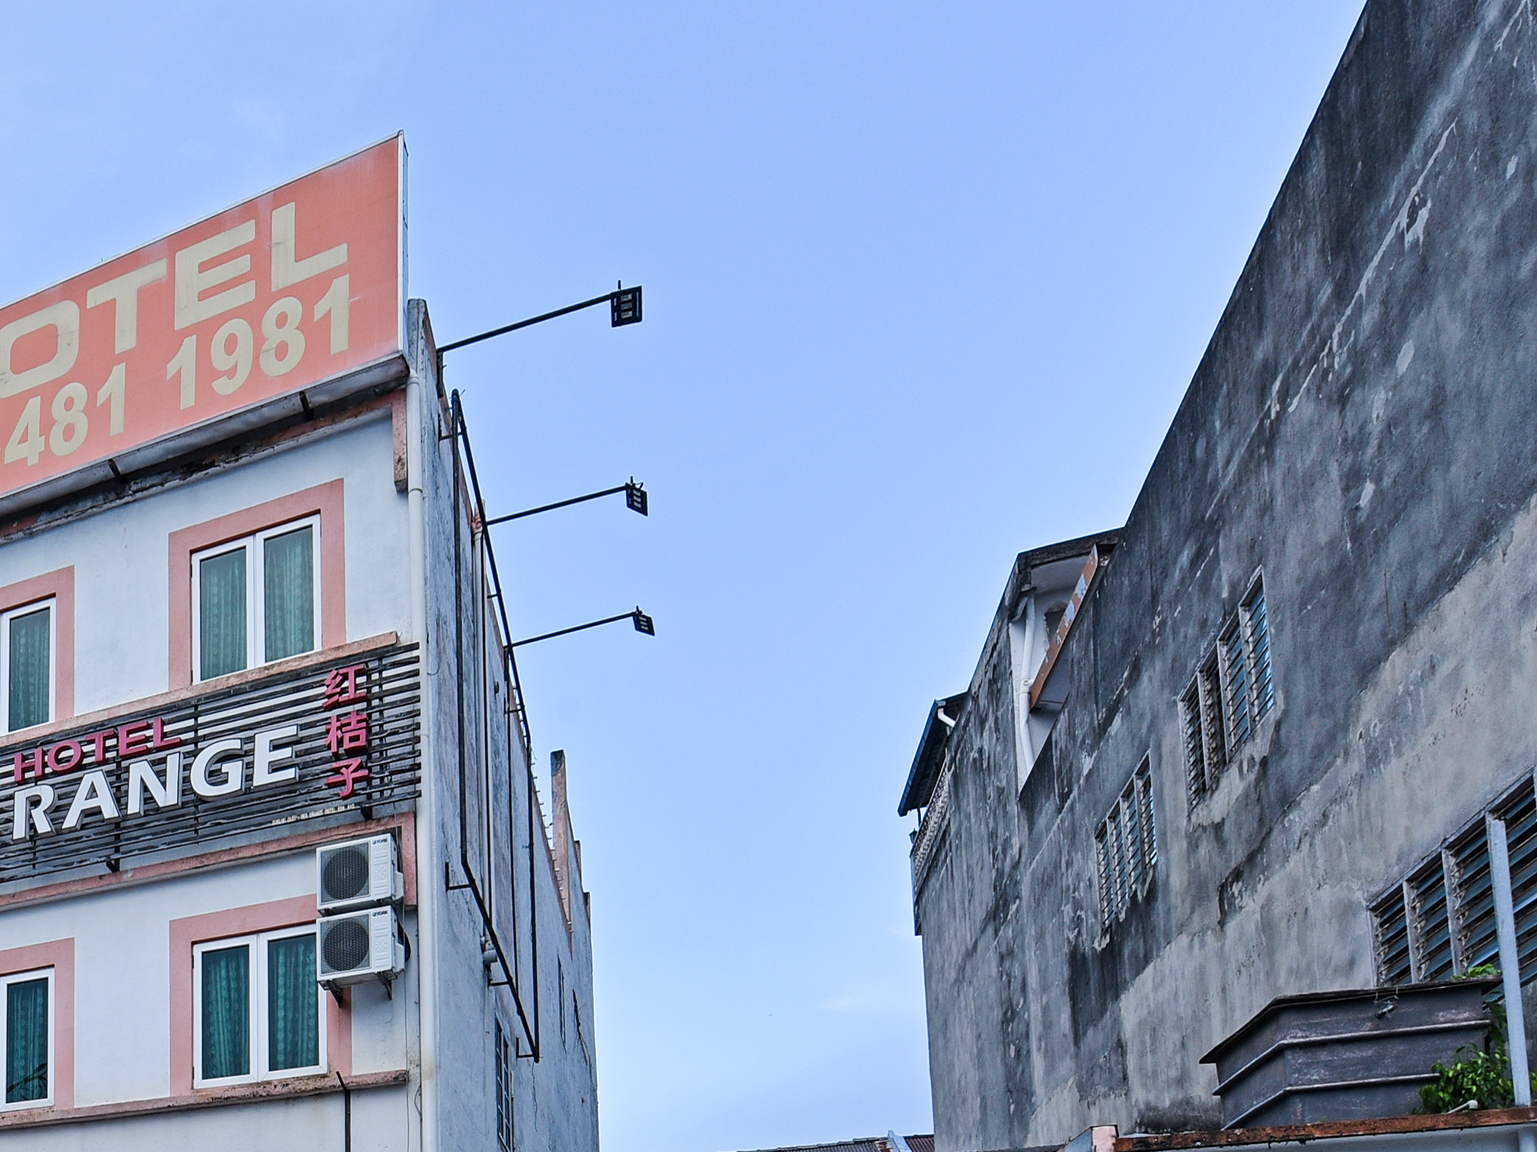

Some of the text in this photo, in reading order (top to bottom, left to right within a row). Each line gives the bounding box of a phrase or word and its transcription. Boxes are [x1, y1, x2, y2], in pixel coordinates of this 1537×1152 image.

[165, 273, 351, 410] 1981
[13, 717, 185, 784] HOTEL
[323, 662, 369, 800] 红桔子
